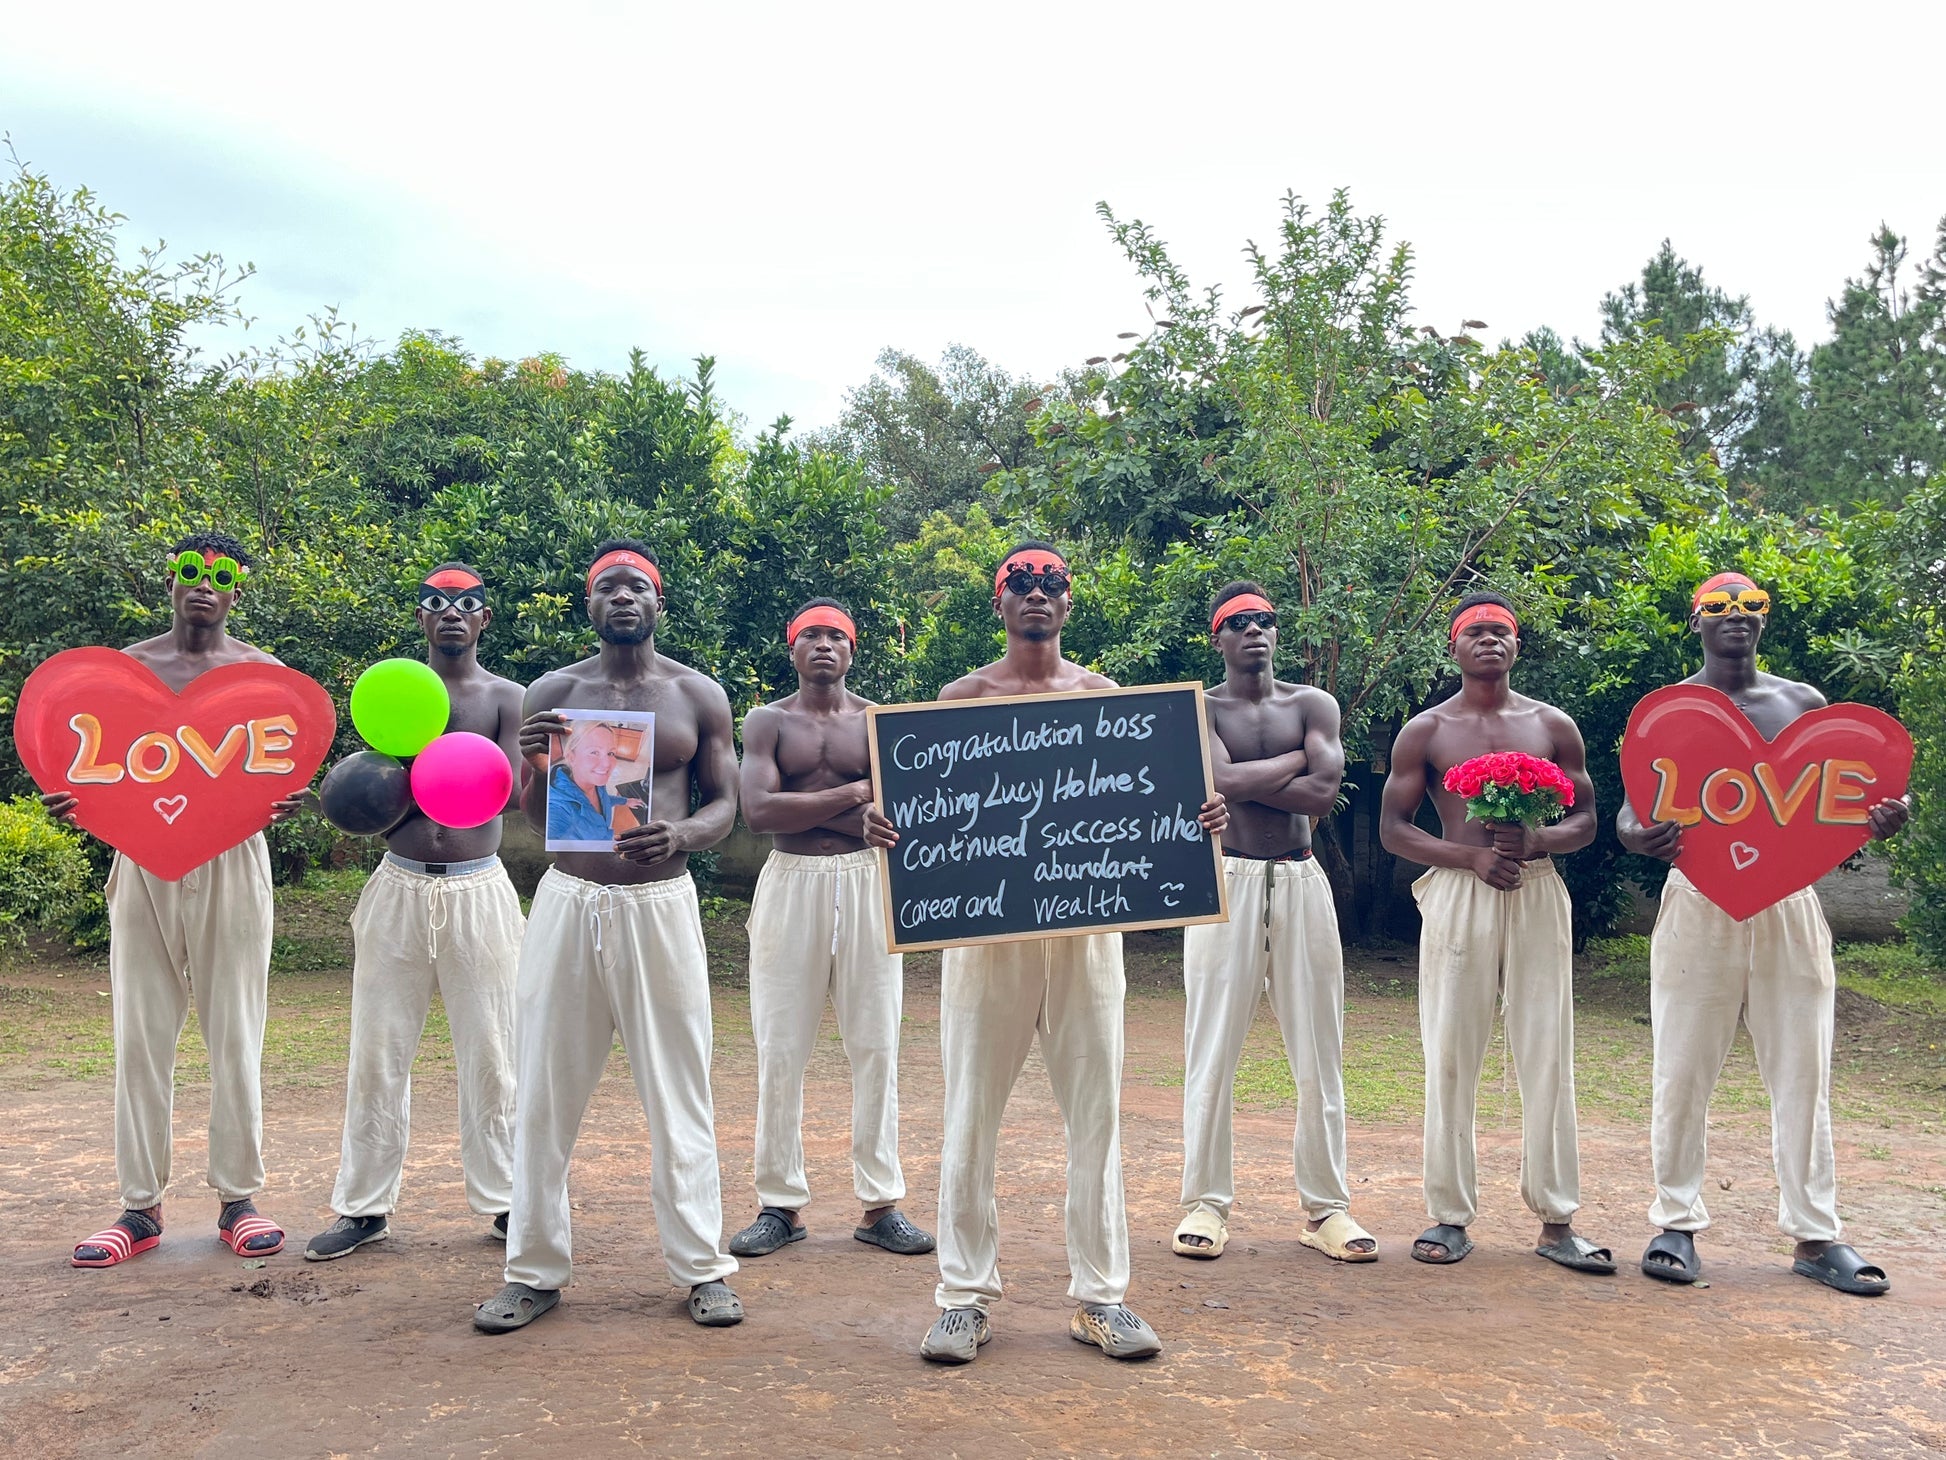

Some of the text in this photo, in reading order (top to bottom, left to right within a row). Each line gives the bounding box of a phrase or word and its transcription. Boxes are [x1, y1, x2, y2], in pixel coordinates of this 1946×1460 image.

[66, 713, 297, 784] LOVE
[892, 705, 1157, 778] Congratulation boss
[892, 758, 1156, 833] Wishing Lucy Holmes
[1651, 758, 1876, 826] LOVE
[964, 878, 1006, 918] and
[1033, 848, 1154, 883] abundant
